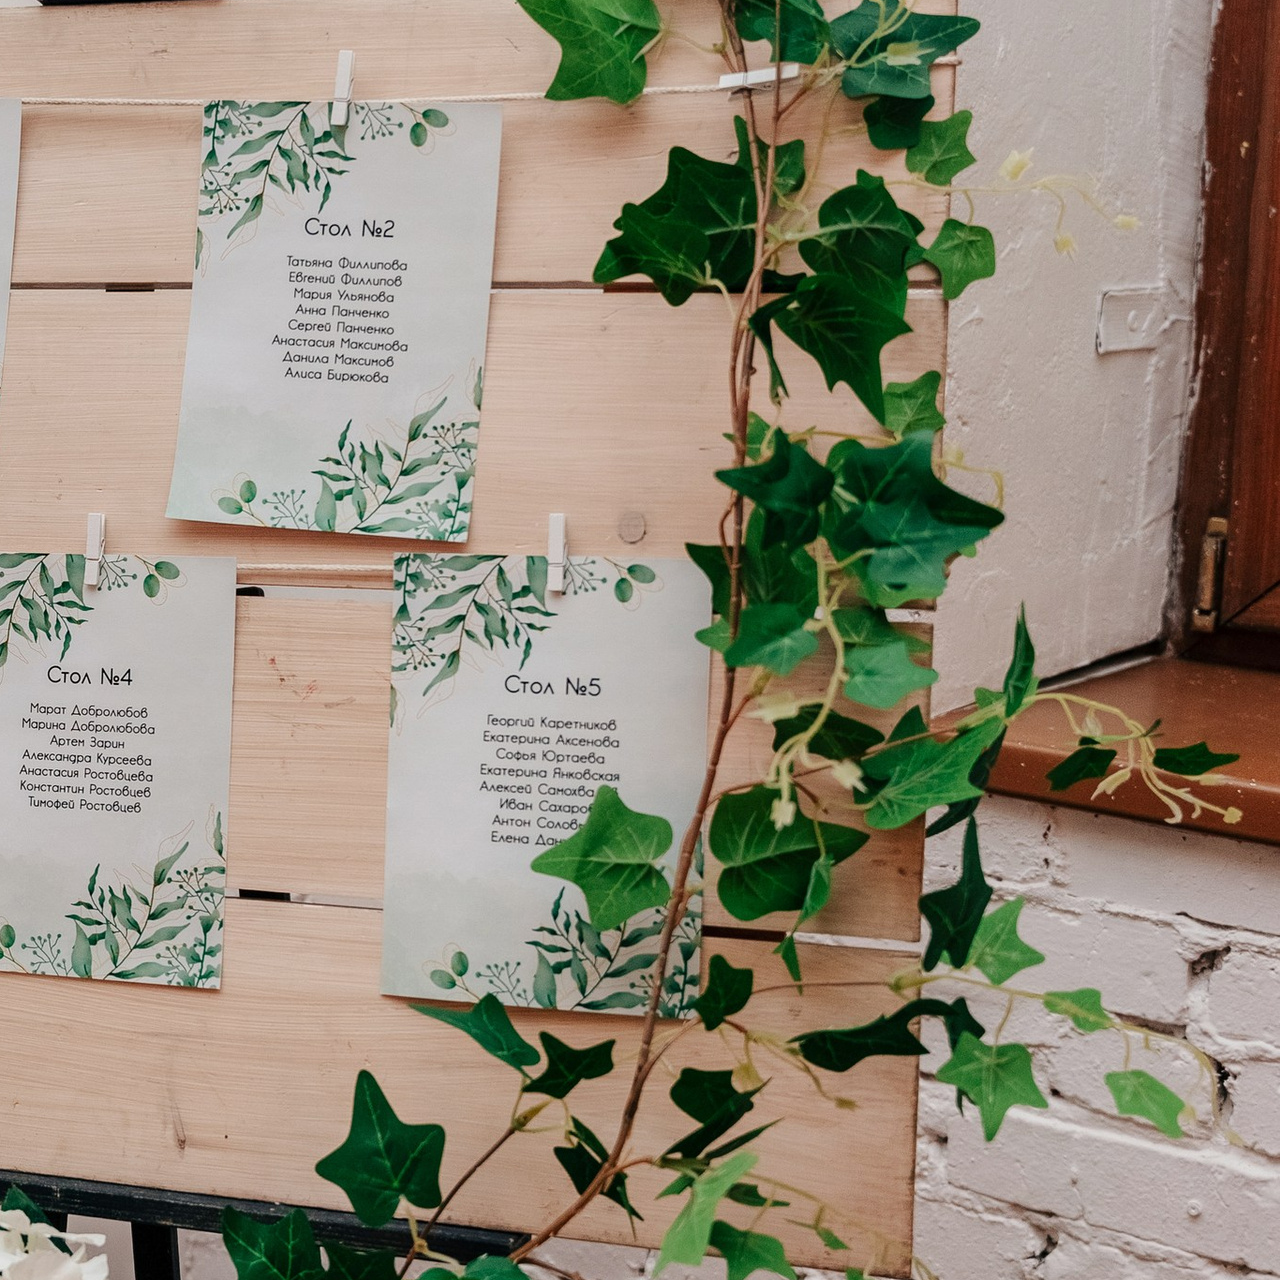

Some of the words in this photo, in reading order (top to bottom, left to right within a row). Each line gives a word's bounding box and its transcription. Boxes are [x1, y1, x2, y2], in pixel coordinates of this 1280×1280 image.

[305, 217, 351, 237] Стол
[362, 219, 395, 238] №2
[287, 255, 332, 267] Татьяна
[339, 257, 407, 271] Филлипова
[289, 272, 335, 284] Евгений
[341, 273, 402, 287] Филлипов
[294, 288, 332, 301] Мария
[338, 290, 394, 303] Ульянова
[295, 304, 326, 316] Анна
[332, 305, 389, 319] Панченко
[288, 319, 331, 332] Сергей
[337, 322, 394, 335] Панченко
[272, 335, 335, 348] Анастасия
[341, 338, 408, 352] Максимова
[282, 351, 329, 364] Данила
[335, 354, 394, 367] Максимов
[285, 368, 322, 379] Алиса
[327, 369, 388, 383] Бирюкова
[47, 665, 91, 684] Стол
[101, 668, 133, 685] №4
[505, 675, 554, 695] Стол
[566, 678, 601, 696] №5
[30, 703, 66, 715] Марат
[71, 705, 148, 718] Добролюбов
[22, 718, 66, 731] Марина
[71, 721, 155, 734] Добролюбова
[487, 715, 534, 728] Георгий
[541, 717, 616, 731] Каретников
[50, 735, 84, 747] Артем
[90, 737, 124, 749] Зарин
[483, 731, 550, 745] Екатерина
[556, 735, 619, 748] Аксенова
[22, 750, 91, 764] Александра
[97, 753, 151, 766] Курсеева
[496, 748, 536, 761] Софья
[542, 750, 605, 764] Юртаева
[19, 765, 79, 778] Анастасия
[84, 768, 153, 782] Ростовцева
[480, 764, 547, 778] Екатерина
[553, 768, 620, 782] Янковская
[20, 781, 84, 794] Константин
[90, 784, 151, 798] Ростовцев
[480, 781, 532, 794] Алексей
[538, 784, 619, 798] Самохва
[28, 796, 74, 810] Тимофей
[80, 800, 141, 813] Ростовцев
[500, 799, 532, 811] Иван
[492, 816, 531, 828] Антон
[491, 832, 529, 844] Елена
